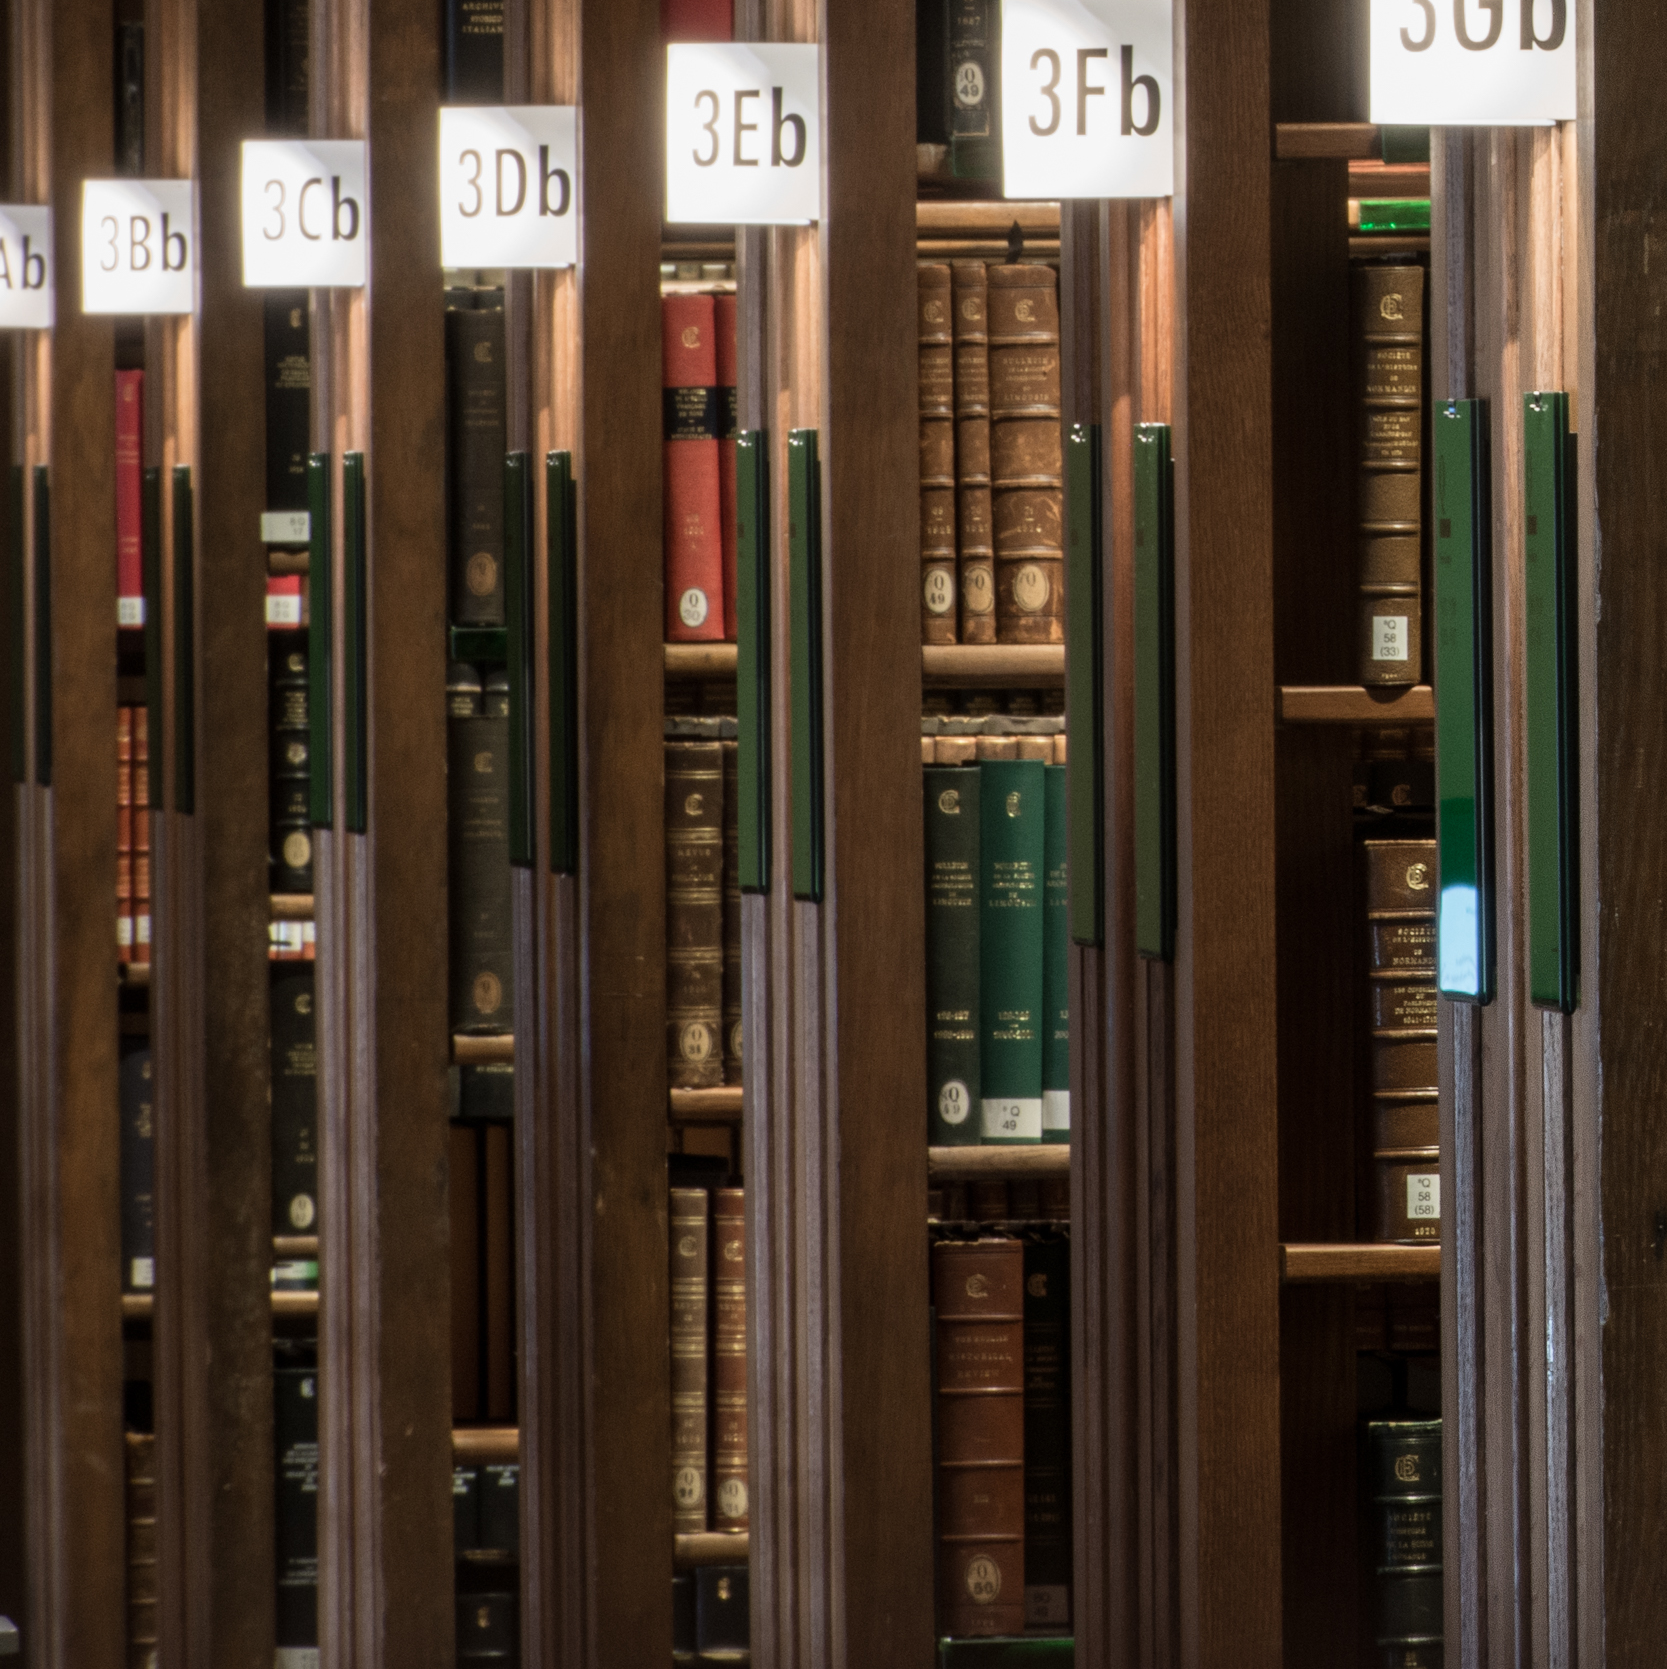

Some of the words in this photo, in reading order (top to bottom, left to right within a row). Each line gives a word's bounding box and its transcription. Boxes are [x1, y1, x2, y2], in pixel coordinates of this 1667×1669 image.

[960, 85, 978, 96] 49
[1031, 43, 1161, 136] 3Fb
[695, 85, 807, 167] 3Eb
[263, 173, 360, 241] 3Cb
[461, 143, 571, 216] 3Db
[100, 210, 188, 271] 3Bb
[1384, 633, 1395, 643] 58
[1419, 1192, 1430, 1201] 58
